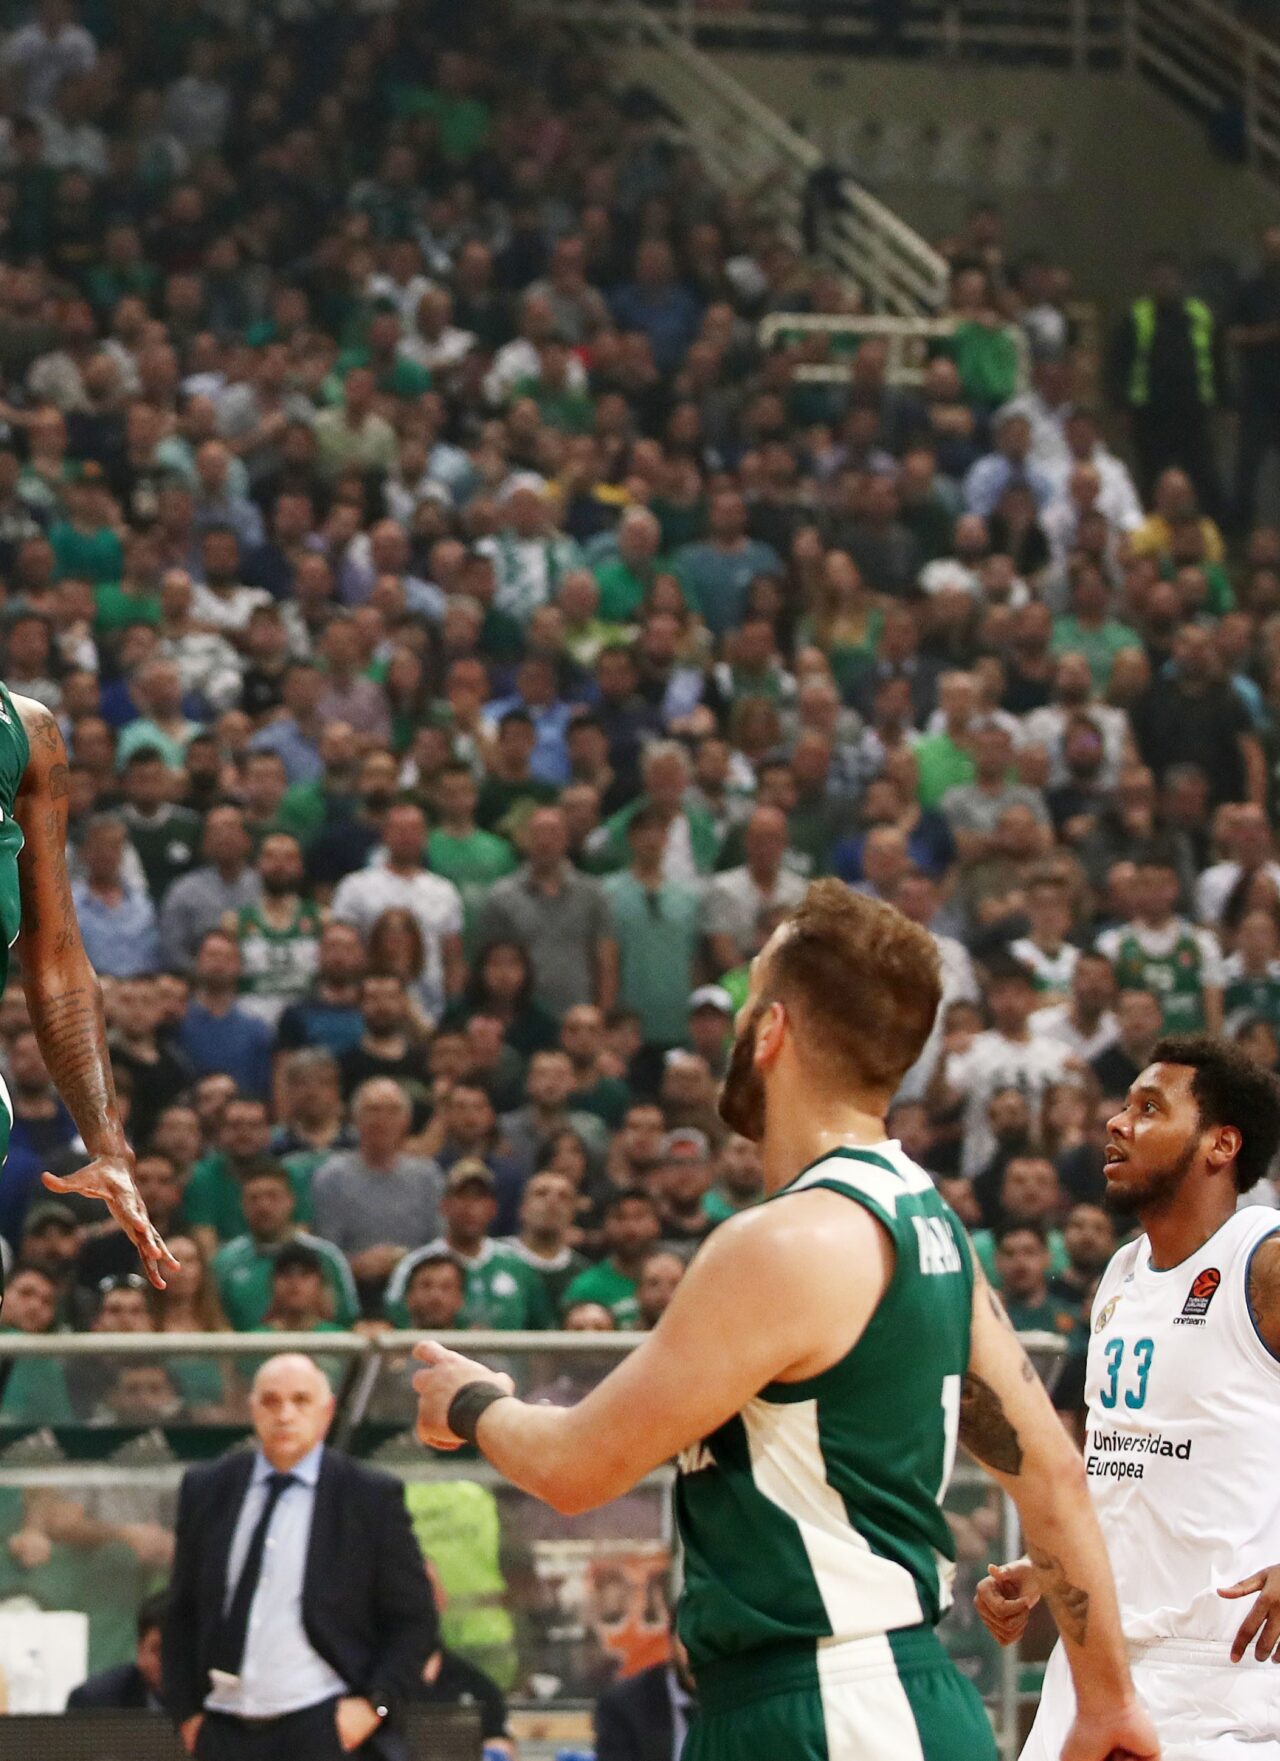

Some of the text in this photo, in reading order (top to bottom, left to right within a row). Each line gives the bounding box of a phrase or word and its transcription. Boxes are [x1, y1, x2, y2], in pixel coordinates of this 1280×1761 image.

[1100, 1336, 1154, 1410] 33
[1093, 1430, 1192, 1460] Universidad
[1086, 1456, 1144, 1481] Europea
